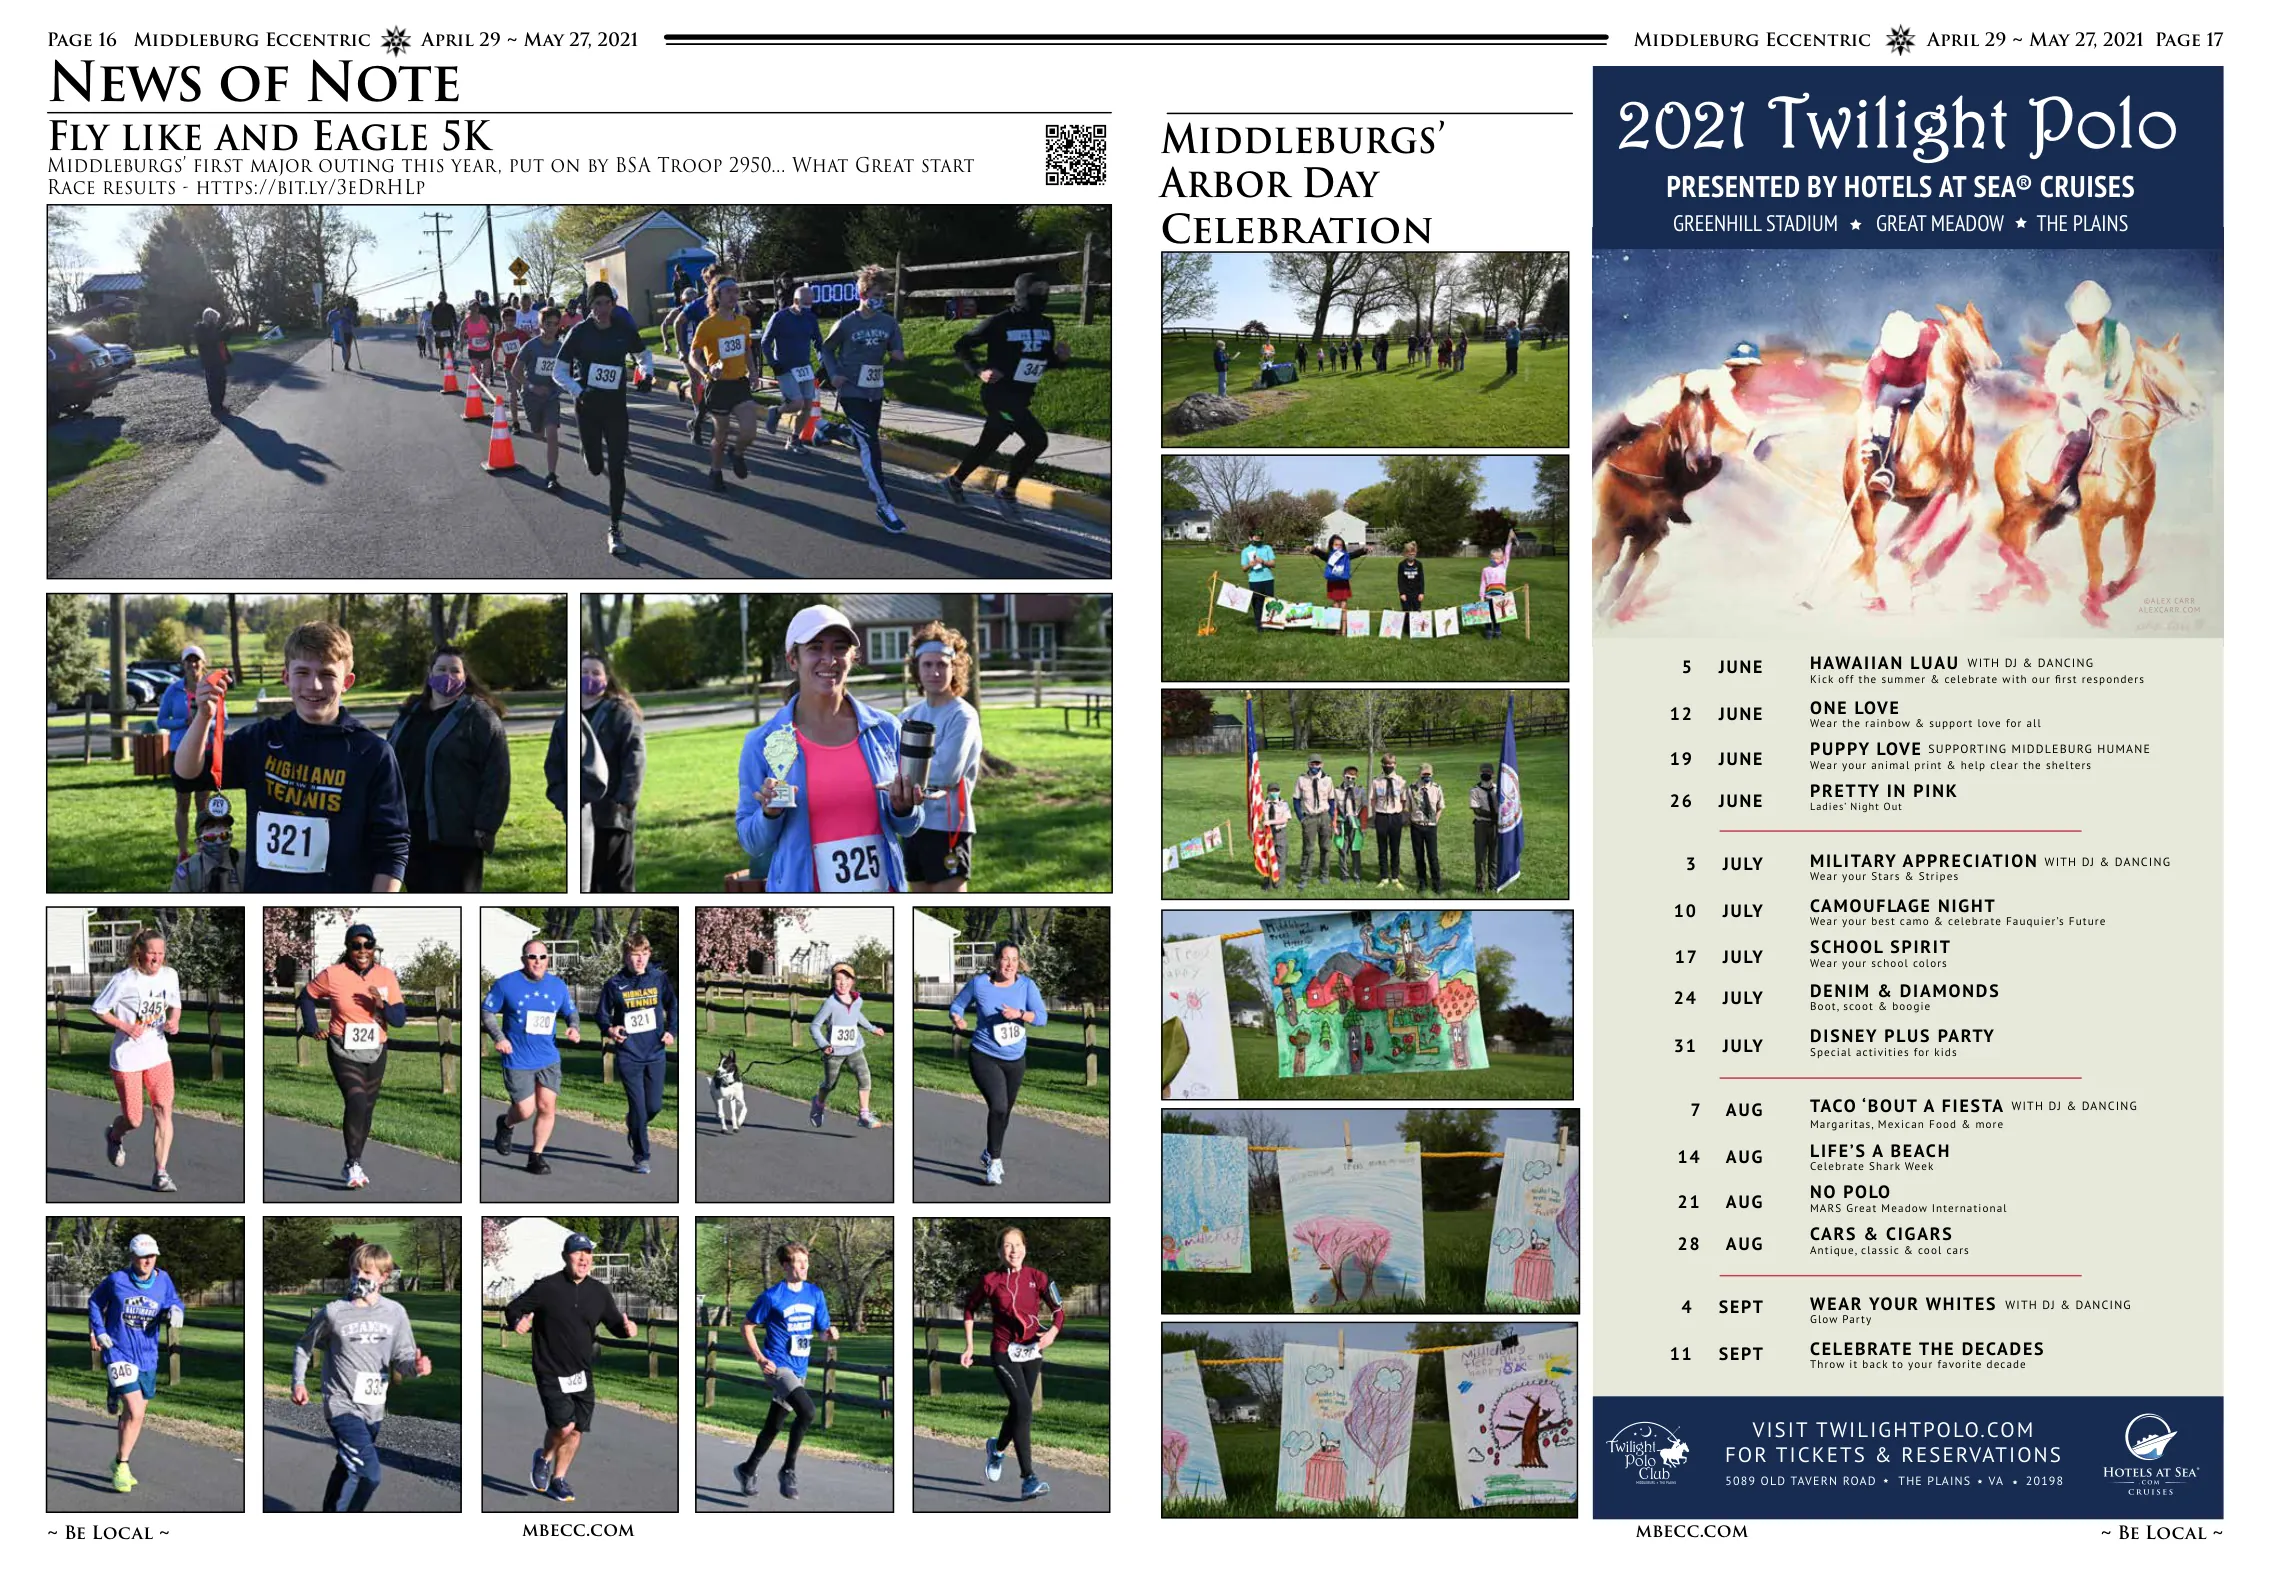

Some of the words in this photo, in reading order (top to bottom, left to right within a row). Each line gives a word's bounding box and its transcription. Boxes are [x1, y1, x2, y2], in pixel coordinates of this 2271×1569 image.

[49, 32, 92, 46] PAGE
[100, 32, 116, 46] 16
[134, 32, 258, 46] MIDDLEBURG
[267, 32, 370, 46] ECCENTRIC
[421, 32, 474, 46] APRIL
[480, 32, 500, 46] 29
[524, 32, 564, 46] MAY
[570, 32, 591, 48] 27,
[598, 32, 637, 46] 2021
[1634, 32, 1758, 46] MIDDLEBURG
[1767, 32, 1870, 46] ECCENTRIC
[1927, 32, 1979, 46] APRIL
[1985, 32, 2005, 46] 29
[2030, 32, 2070, 46] MAY
[2075, 32, 2096, 47] 27,
[2103, 32, 2142, 46] 2021
[2157, 32, 2200, 46] PAGE
[2208, 32, 2223, 46] 17
[50, 59, 201, 102] NEWS
[221, 66, 288, 102] OF
[308, 59, 459, 102] NOTE
[1619, 101, 1744, 149] 2021
[1768, 93, 2007, 163] Twilight
[2029, 95, 2176, 159] Polo
[49, 120, 110, 150] FLY
[123, 124, 201, 150] LIKE
[214, 124, 298, 151] AND
[314, 120, 427, 151] EAGLE
[444, 120, 493, 151] 5K
[1161, 120, 1444, 154] MIDDLEBURGS’
[48, 156, 185, 172] MIDDLEBURGS’
[195, 159, 243, 172] FIRST
[251, 159, 312, 176] MAJOR
[319, 159, 393, 172] OUTING
[402, 159, 443, 172] THIS
[451, 159, 501, 174] YEAR,
[511, 159, 544, 172] PUT
[551, 159, 579, 172] ON
[589, 159, 608, 172] BY
[617, 157, 650, 172] BSA
[658, 157, 722, 172] TROOP
[730, 157, 784, 172] 2950...
[792, 157, 848, 172] WHAT
[856, 157, 914, 172] GREAT
[922, 159, 974, 172] START
[49, 179, 94, 194] RACE
[104, 181, 175, 194] RESULTS
[1158, 167, 1292, 198] ARBOR
[1304, 167, 1380, 198] DAY
[1668, 176, 1799, 198] PRESENTED
[1808, 176, 1837, 197] BY
[1845, 176, 1932, 198] HOTELS
[1939, 176, 1967, 197] AT
[2041, 176, 2134, 198] CRUISES
[1163, 213, 1432, 244] CELEBRATION
[1674, 215, 1762, 231] GREENHILL
[1767, 215, 1837, 231] STADIUM
[1877, 215, 1927, 231] GREAT
[1932, 215, 2004, 231] MEADOW
[2037, 215, 2067, 231] THE
[2074, 215, 2128, 231] PLAINS
[724, 339, 741, 352] 338
[595, 368, 616, 383] 339
[2138, 605, 2201, 614] ALEXCARR.COM
[1683, 660, 1691, 673] 5
[1718, 660, 1762, 673] JUNE
[1811, 656, 1901, 669] HAWAIIAN
[1911, 656, 1957, 669] LUAU
[1967, 657, 1999, 668] WITH
[2005, 657, 2017, 668] DJ
[2023, 657, 2032, 668] &
[2038, 657, 2094, 668] DANCING
[264, 755, 346, 787] HIGHLAND
[264, 779, 342, 812] TENNIS
[267, 822, 311, 857] 321
[832, 845, 880, 883] 325
[1811, 854, 1895, 867] MILITARY
[1903, 854, 2036, 867] APPRECIATION
[1811, 899, 1929, 912] CAMOUFLAGE
[1939, 899, 1995, 912] NIGHT
[1811, 984, 1868, 997] DENIM
[1879, 984, 1890, 997] &
[1901, 984, 1998, 997] DIAMONDS
[141, 1001, 162, 1014] 345
[625, 997, 658, 1008] TENNIS
[532, 1016, 550, 1028] 320
[631, 1014, 649, 1028] 321
[353, 1028, 374, 1042] 324
[837, 1028, 855, 1041] 330
[1000, 1025, 1020, 1039] 318
[1810, 1047, 1852, 1059] Special
[1855, 1047, 1909, 1057] activities
[1913, 1047, 1930, 1057] for
[1934, 1047, 1957, 1057] kids
[1810, 1203, 1842, 1213] MARS
[1846, 1203, 1877, 1213] Great
[1881, 1203, 1928, 1213] Meadow
[1932, 1203, 2007, 1213] International
[1811, 1342, 1911, 1355] CELEBRATE
[1919, 1342, 1953, 1355] THE
[1963, 1342, 2043, 1355] DECADES
[111, 1364, 132, 1380] 346
[1753, 1422, 1807, 1437] VISIT
[1816, 1422, 2032, 1437] TWILIGHTPOLO.COM
[1606, 1440, 1656, 1456] Twilight
[1727, 1447, 1766, 1462] FOR
[1776, 1447, 1864, 1462] TICKETS
[1877, 1447, 1890, 1462] &
[1903, 1447, 2060, 1462] RESERVATIONS
[1625, 1454, 1656, 1469] Polo
[1639, 1467, 1670, 1479] Club
[2103, 1466, 2153, 1478] HOTELS
[2155, 1467, 2172, 1478] AT
[1725, 1475, 1755, 1486] 5089
[1760, 1475, 1786, 1486] OLD
[1790, 1475, 1837, 1486] TAVERN
[1843, 1475, 1876, 1486] ROAD
[1898, 1475, 1922, 1486] THE
[1927, 1475, 1971, 1486] PLAINS
[1988, 1476, 2004, 1486] VA
[2026, 1475, 2063, 1486] 20198
[2127, 1488, 2174, 1496] CRUISES
[66, 1525, 85, 1539] BE
[93, 1525, 153, 1539] LOCAL
[523, 1524, 634, 1536] MBECC.COM
[1636, 1525, 1748, 1537] MBECC.COM
[2119, 1525, 2139, 1539] BE
[2147, 1525, 2206, 1539] LOCAL
